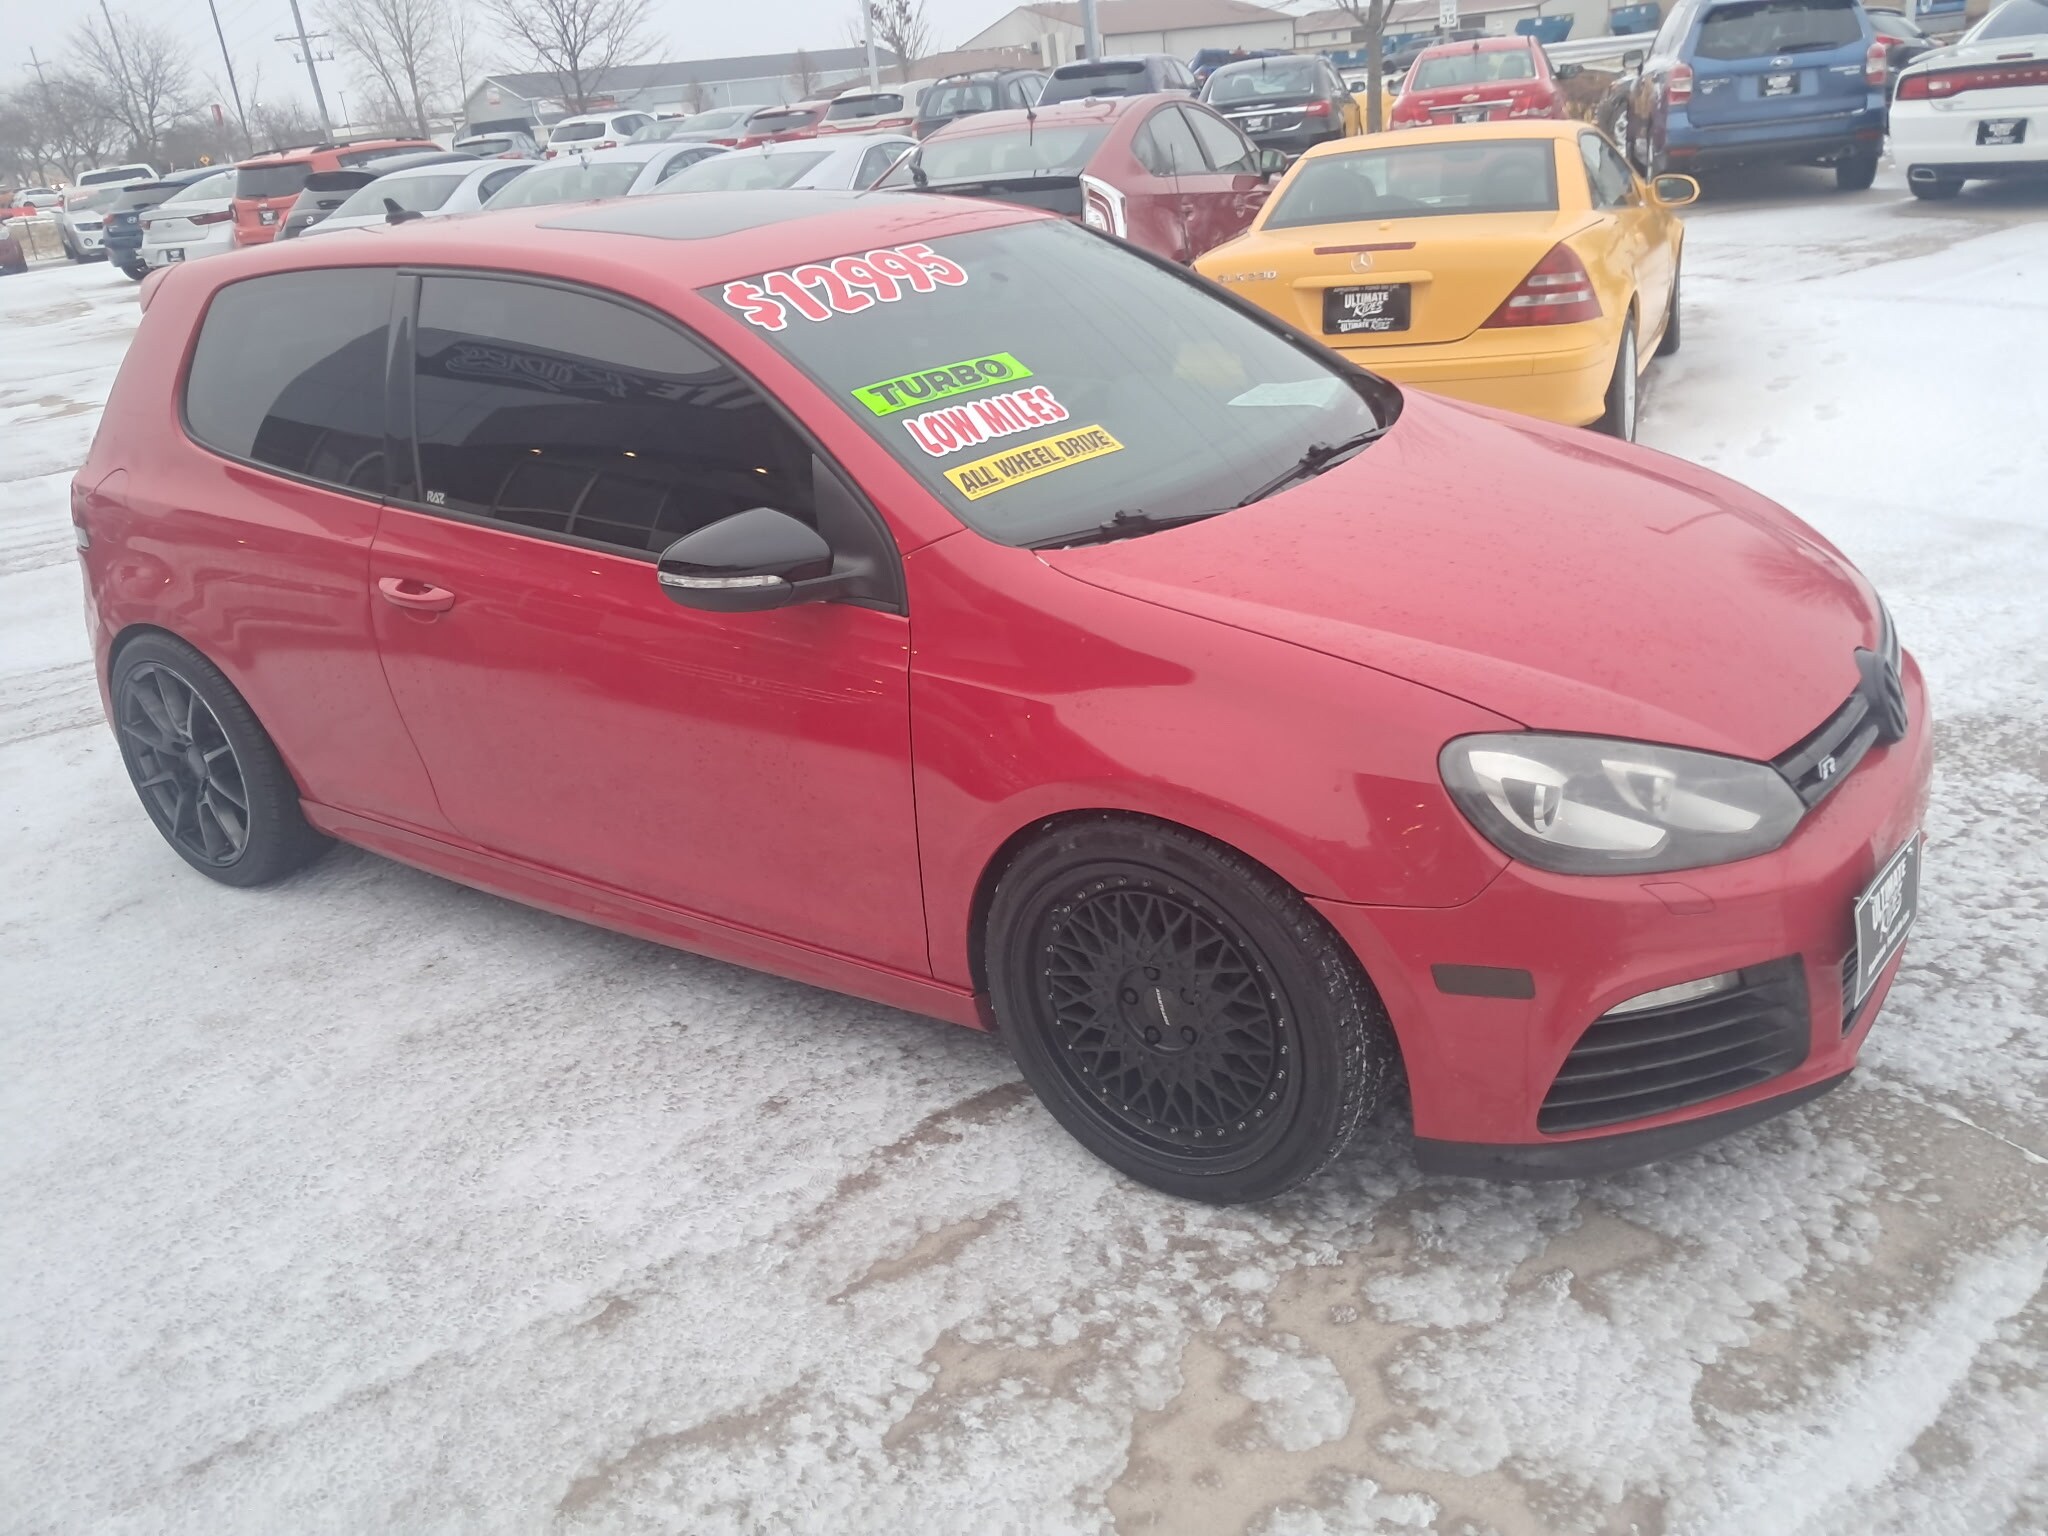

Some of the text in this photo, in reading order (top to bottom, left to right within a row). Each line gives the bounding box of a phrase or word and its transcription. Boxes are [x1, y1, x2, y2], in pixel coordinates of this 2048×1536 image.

[723, 243, 968, 331] $12995
[1344, 291, 1389, 309] ULTIMATE
[1353, 301, 1385, 317] RIDES
[869, 359, 1012, 408] TURBO
[905, 387, 1067, 455] LOW MILES
[958, 430, 1114, 493] ALL WHEEL DRIVE
[1871, 857, 1907, 931] ULTIMATE
